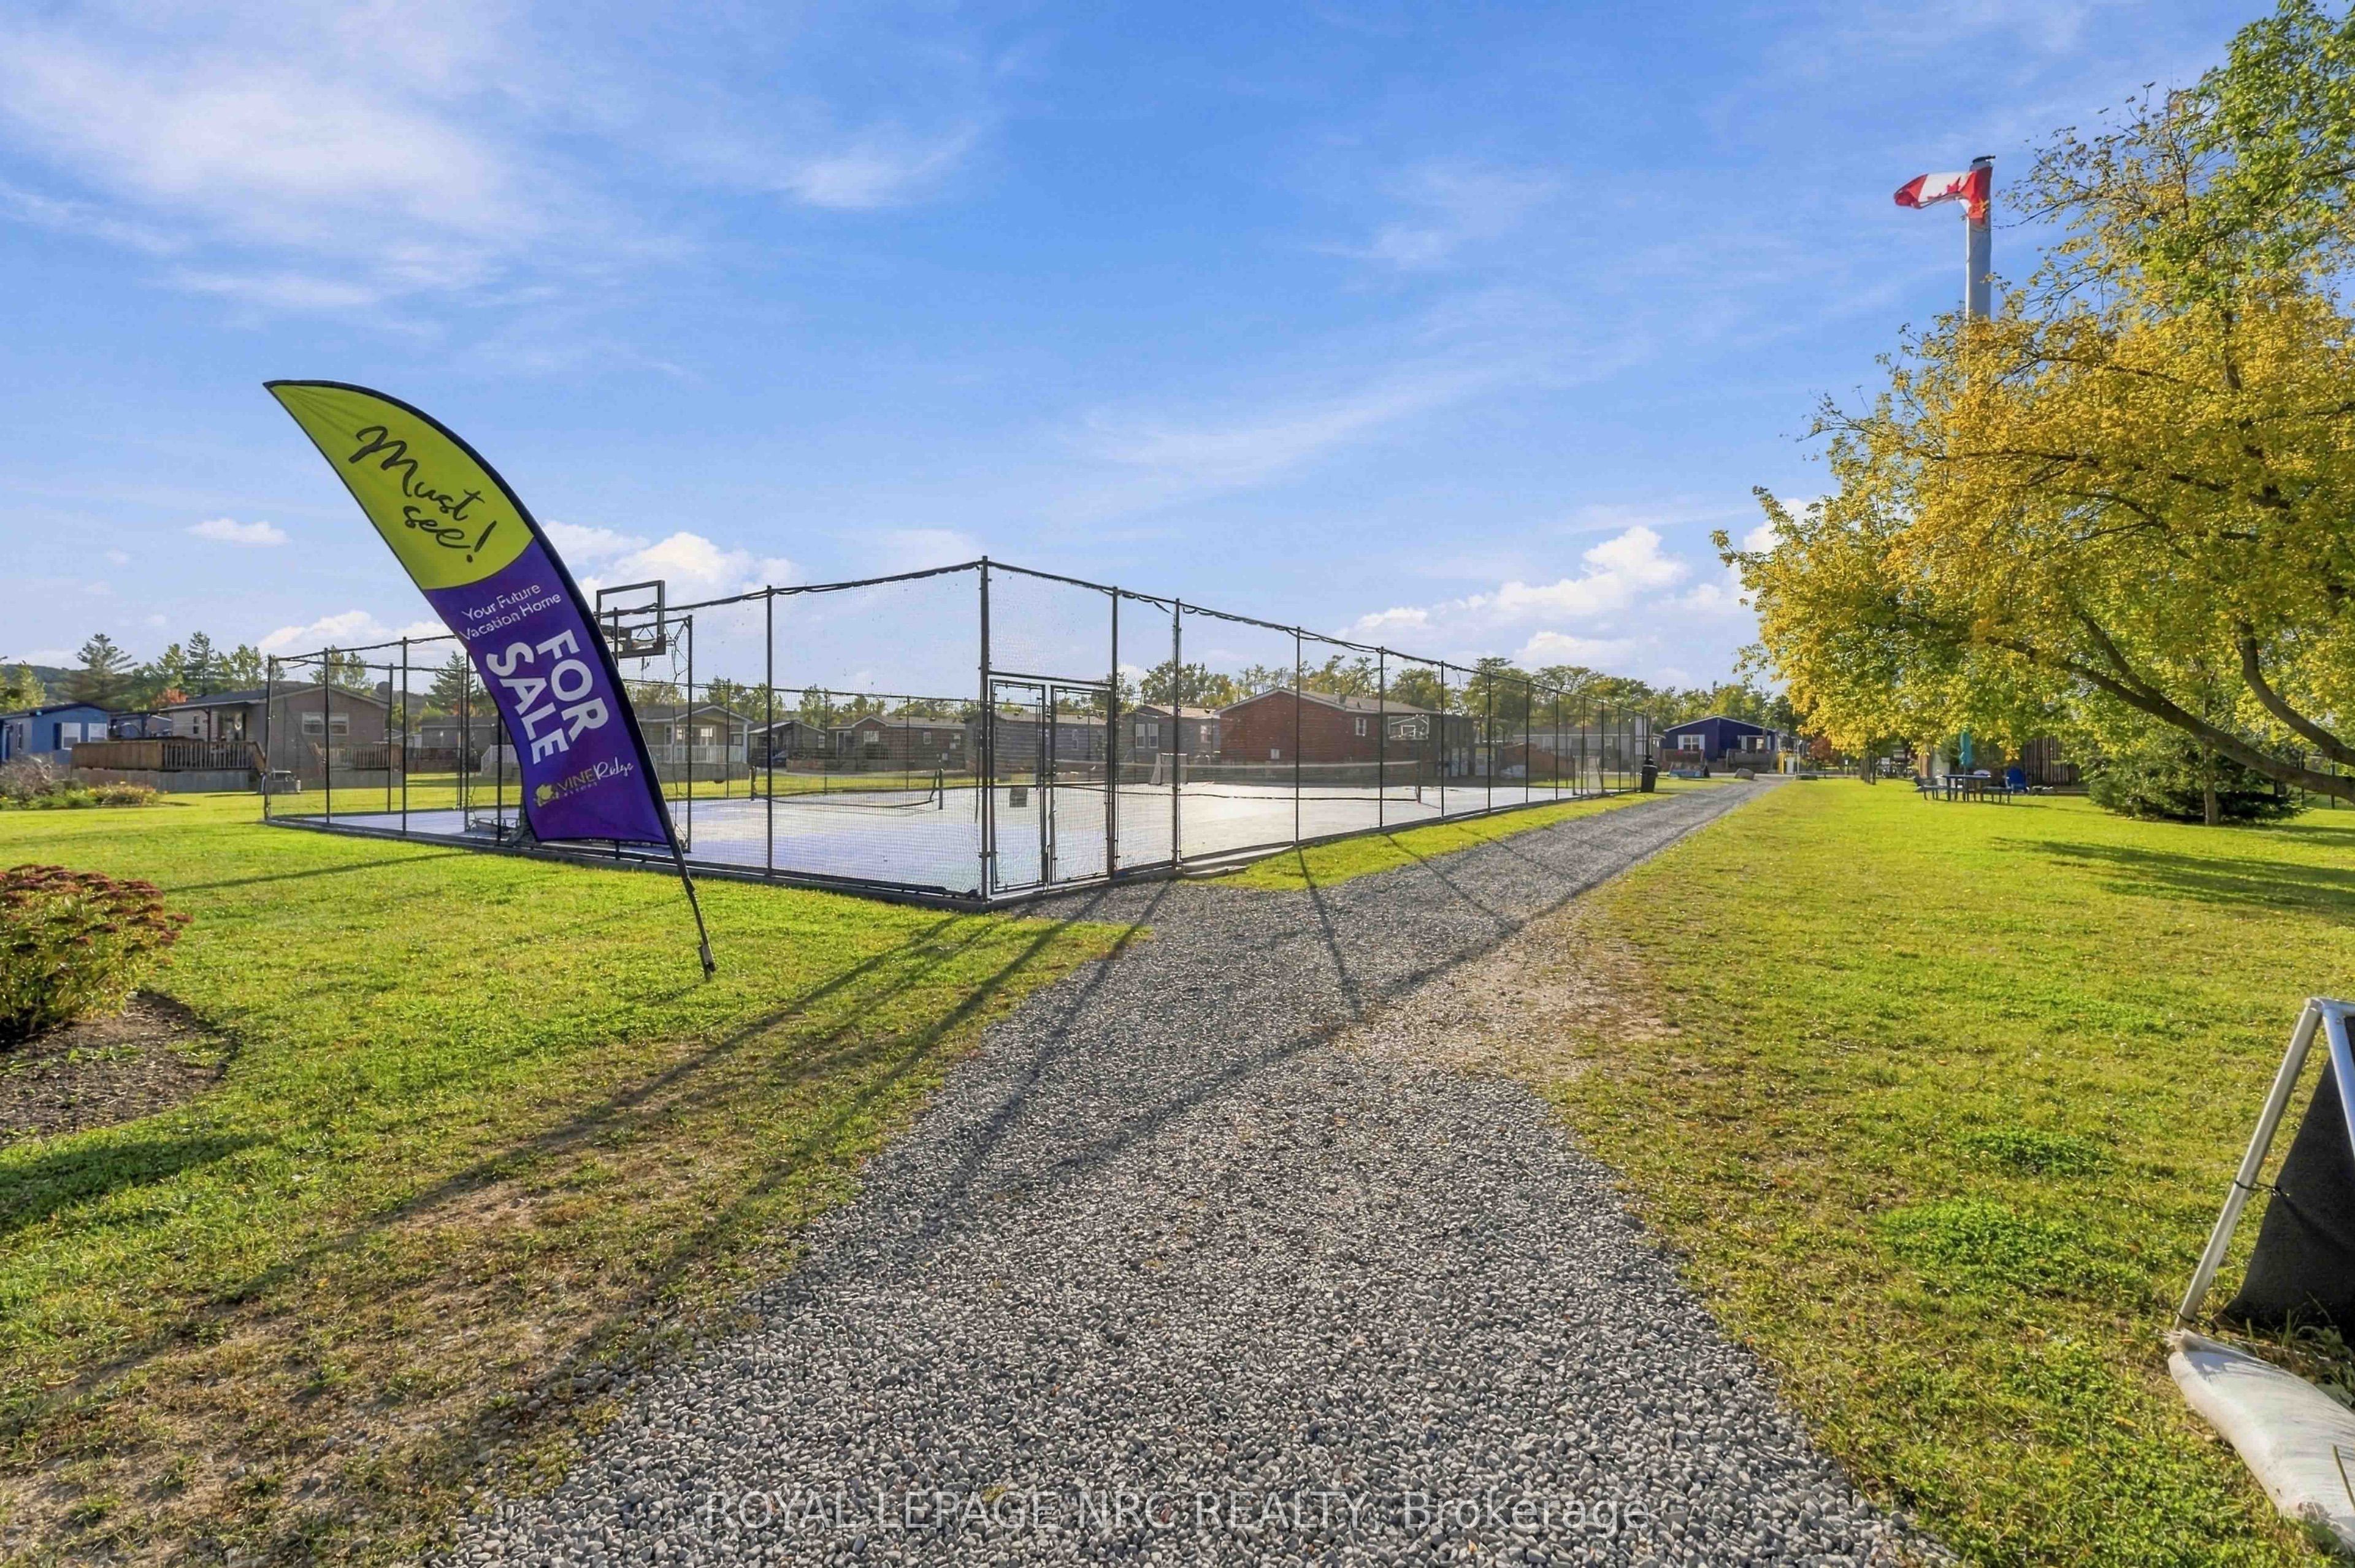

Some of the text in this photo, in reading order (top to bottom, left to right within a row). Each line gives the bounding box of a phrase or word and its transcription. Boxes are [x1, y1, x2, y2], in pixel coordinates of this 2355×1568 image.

[348, 426, 485, 521] Must
[403, 506, 497, 563] see!
[459, 593, 562, 640] Vacation Home
[461, 584, 542, 621] Your Future
[486, 642, 569, 765] SALE
[535, 629, 609, 743] FOR
